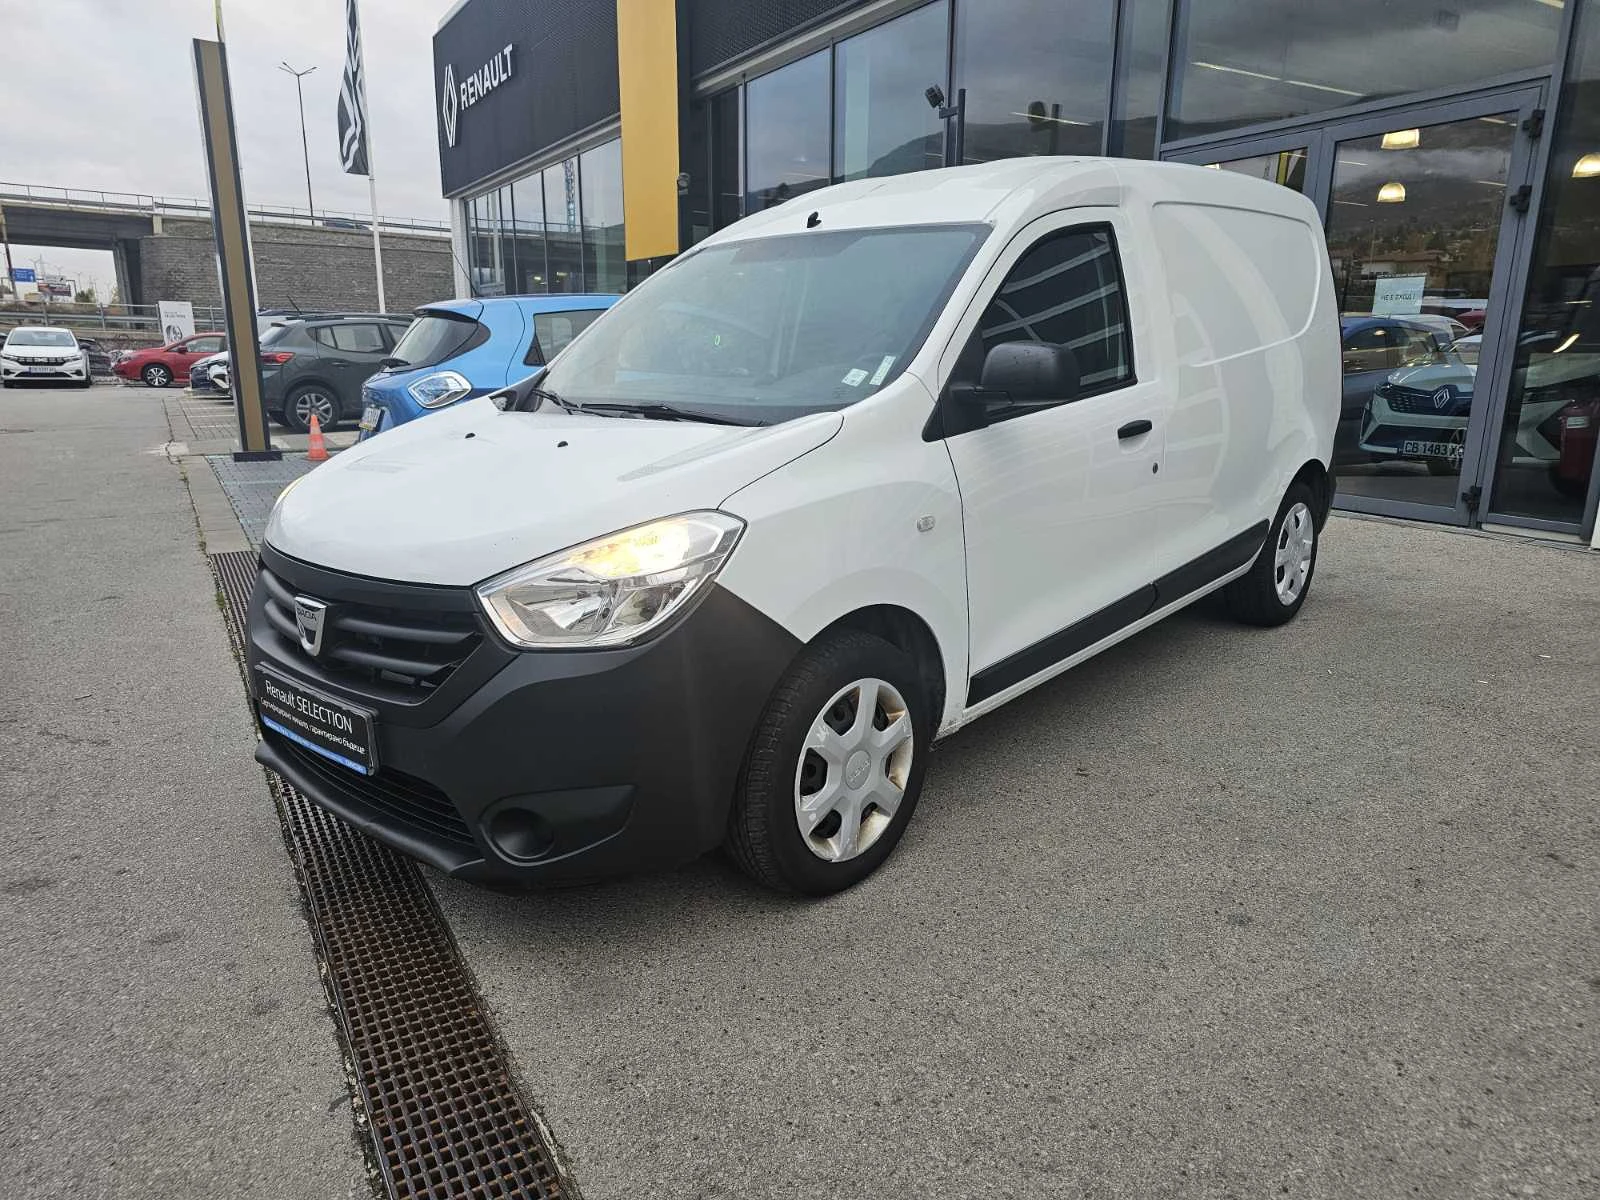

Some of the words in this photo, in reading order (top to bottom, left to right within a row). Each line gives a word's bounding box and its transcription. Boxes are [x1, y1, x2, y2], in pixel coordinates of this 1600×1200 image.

[460, 43, 513, 111] RENAULT
[1405, 441, 1419, 454] CB
[1422, 443, 1448, 456] 1483
[265, 679, 296, 709] Renault
[296, 695, 353, 734] SELECTION
